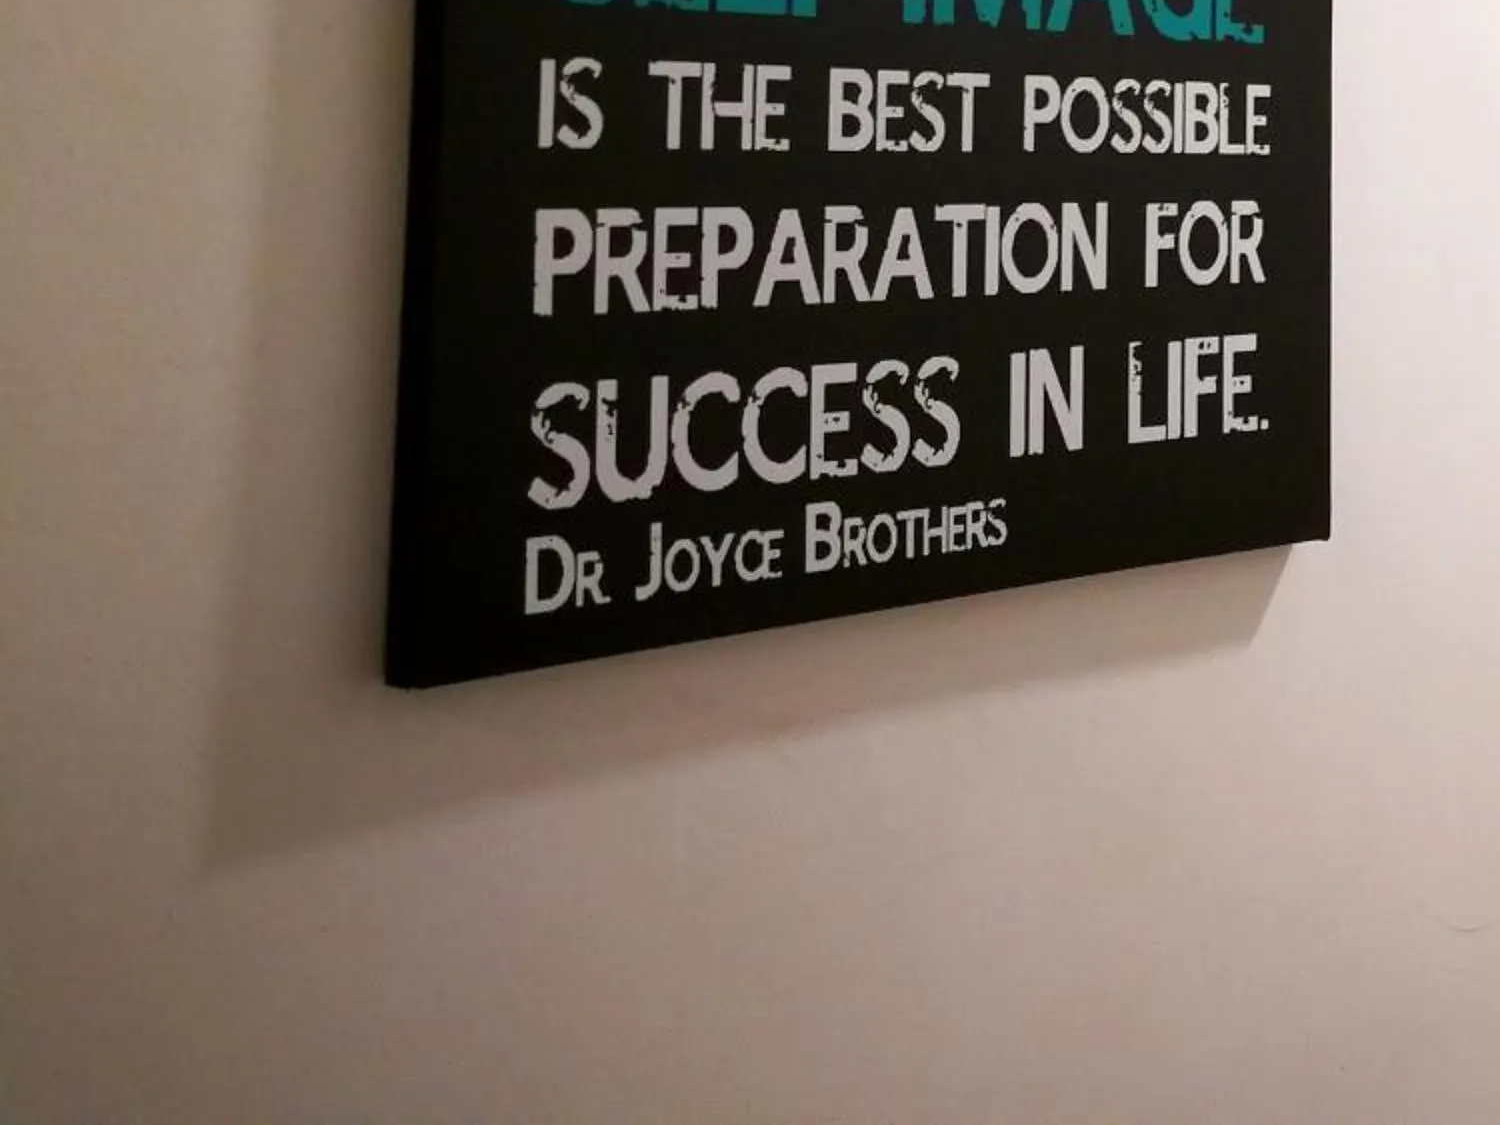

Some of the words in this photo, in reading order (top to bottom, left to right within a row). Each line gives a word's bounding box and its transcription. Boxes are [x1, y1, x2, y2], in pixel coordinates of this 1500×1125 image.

[536, 57, 604, 150] IS
[648, 60, 792, 151] THE
[827, 67, 991, 153] BEST
[1021, 75, 1272, 156] POSSIBLE
[531, 201, 1110, 317] PREPARATION
[1144, 199, 1266, 289] FOR
[526, 355, 962, 512] SUCCESS
[1009, 345, 1085, 459] IN
[1126, 333, 1270, 445] LIFE.
